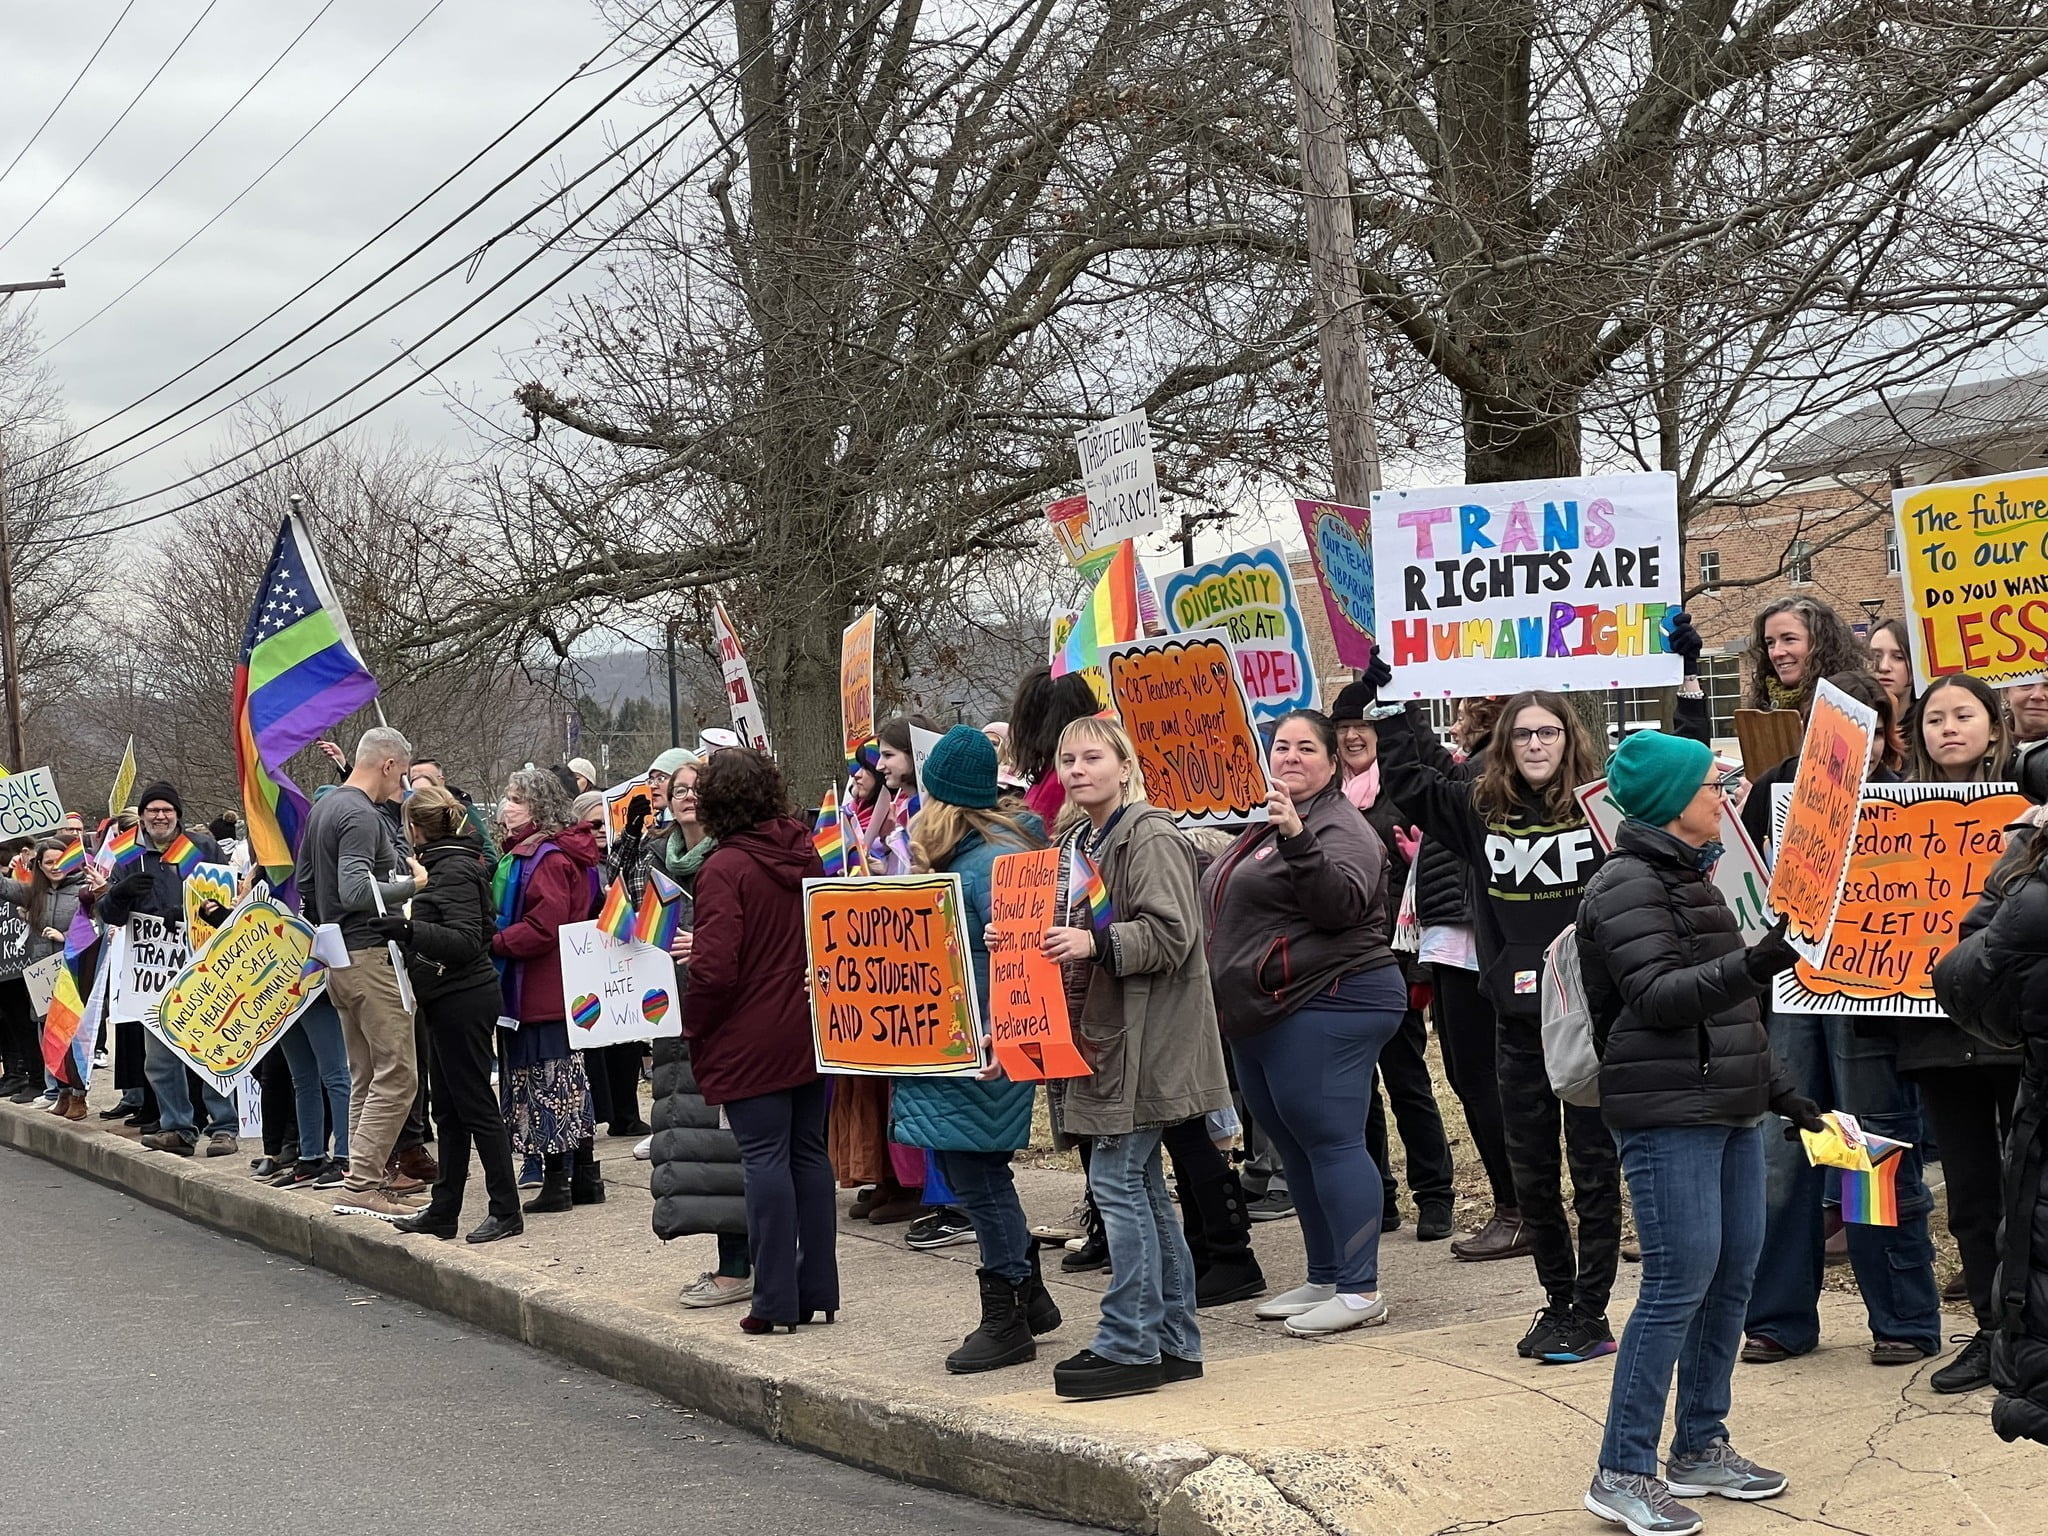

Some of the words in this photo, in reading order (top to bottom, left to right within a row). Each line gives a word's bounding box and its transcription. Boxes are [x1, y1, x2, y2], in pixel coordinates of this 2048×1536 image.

[1078, 420, 1146, 474] THREATENING
[1112, 459, 1138, 485] WITH
[1088, 482, 1157, 538] DEMOCRACY!
[1397, 497, 1615, 559] TRANS
[1912, 504, 1962, 535] The
[1968, 491, 2048, 529] future
[1322, 531, 1345, 562] OUR
[1922, 542, 1957, 573] To
[1974, 540, 2028, 567] our
[1404, 551, 1572, 611] RIGHTS
[1585, 546, 1660, 588] ARE
[1926, 587, 1954, 609] Do
[1960, 580, 1997, 604] YOU
[1180, 570, 1271, 629] DiVERSiTY
[1255, 612, 1276, 641] AT
[1392, 615, 1543, 666] HUMAN
[1125, 677, 1143, 704] CB
[1139, 672, 1192, 702] Teachers,
[1190, 662, 1213, 697] We
[1132, 710, 1160, 743] love
[1161, 711, 1182, 738] and
[1184, 703, 1228, 749] Support
[0, 772, 48, 812] SAVE
[1162, 744, 1226, 803] YOU
[0, 799, 61, 835] CBSD
[1484, 828, 1595, 887] PKF
[1920, 819, 1947, 859] to
[1018, 851, 1055, 889] children
[1925, 867, 1951, 901] to
[993, 892, 1025, 923] should
[1031, 891, 1045, 920] be
[1534, 890, 1562, 900] MARK
[821, 910, 838, 953] I
[847, 906, 933, 952] SUPPORT
[1020, 920, 1043, 951] and
[1923, 910, 1954, 934] US
[568, 931, 594, 956] WE
[168, 977, 217, 1033] iNCLUSiVE
[211, 920, 270, 980] EDUCATiON
[199, 982, 237, 1028] HEALTHY
[241, 943, 278, 976] SAFE
[608, 956, 633, 975] LET
[836, 955, 861, 992] CB
[865, 956, 942, 997] STUDENTS
[995, 955, 1030, 983] heard,
[603, 976, 635, 999] HATE
[1010, 980, 1031, 1006] and
[236, 1040, 252, 1059] CB
[255, 995, 290, 1040] STRONG!
[610, 1002, 640, 1026] WIN
[829, 1002, 863, 1043] AND
[870, 1002, 940, 1047] STAFF
[995, 996, 1050, 1042] believed
[204, 1043, 231, 1065] FOR
[221, 1018, 251, 1043] OUR
